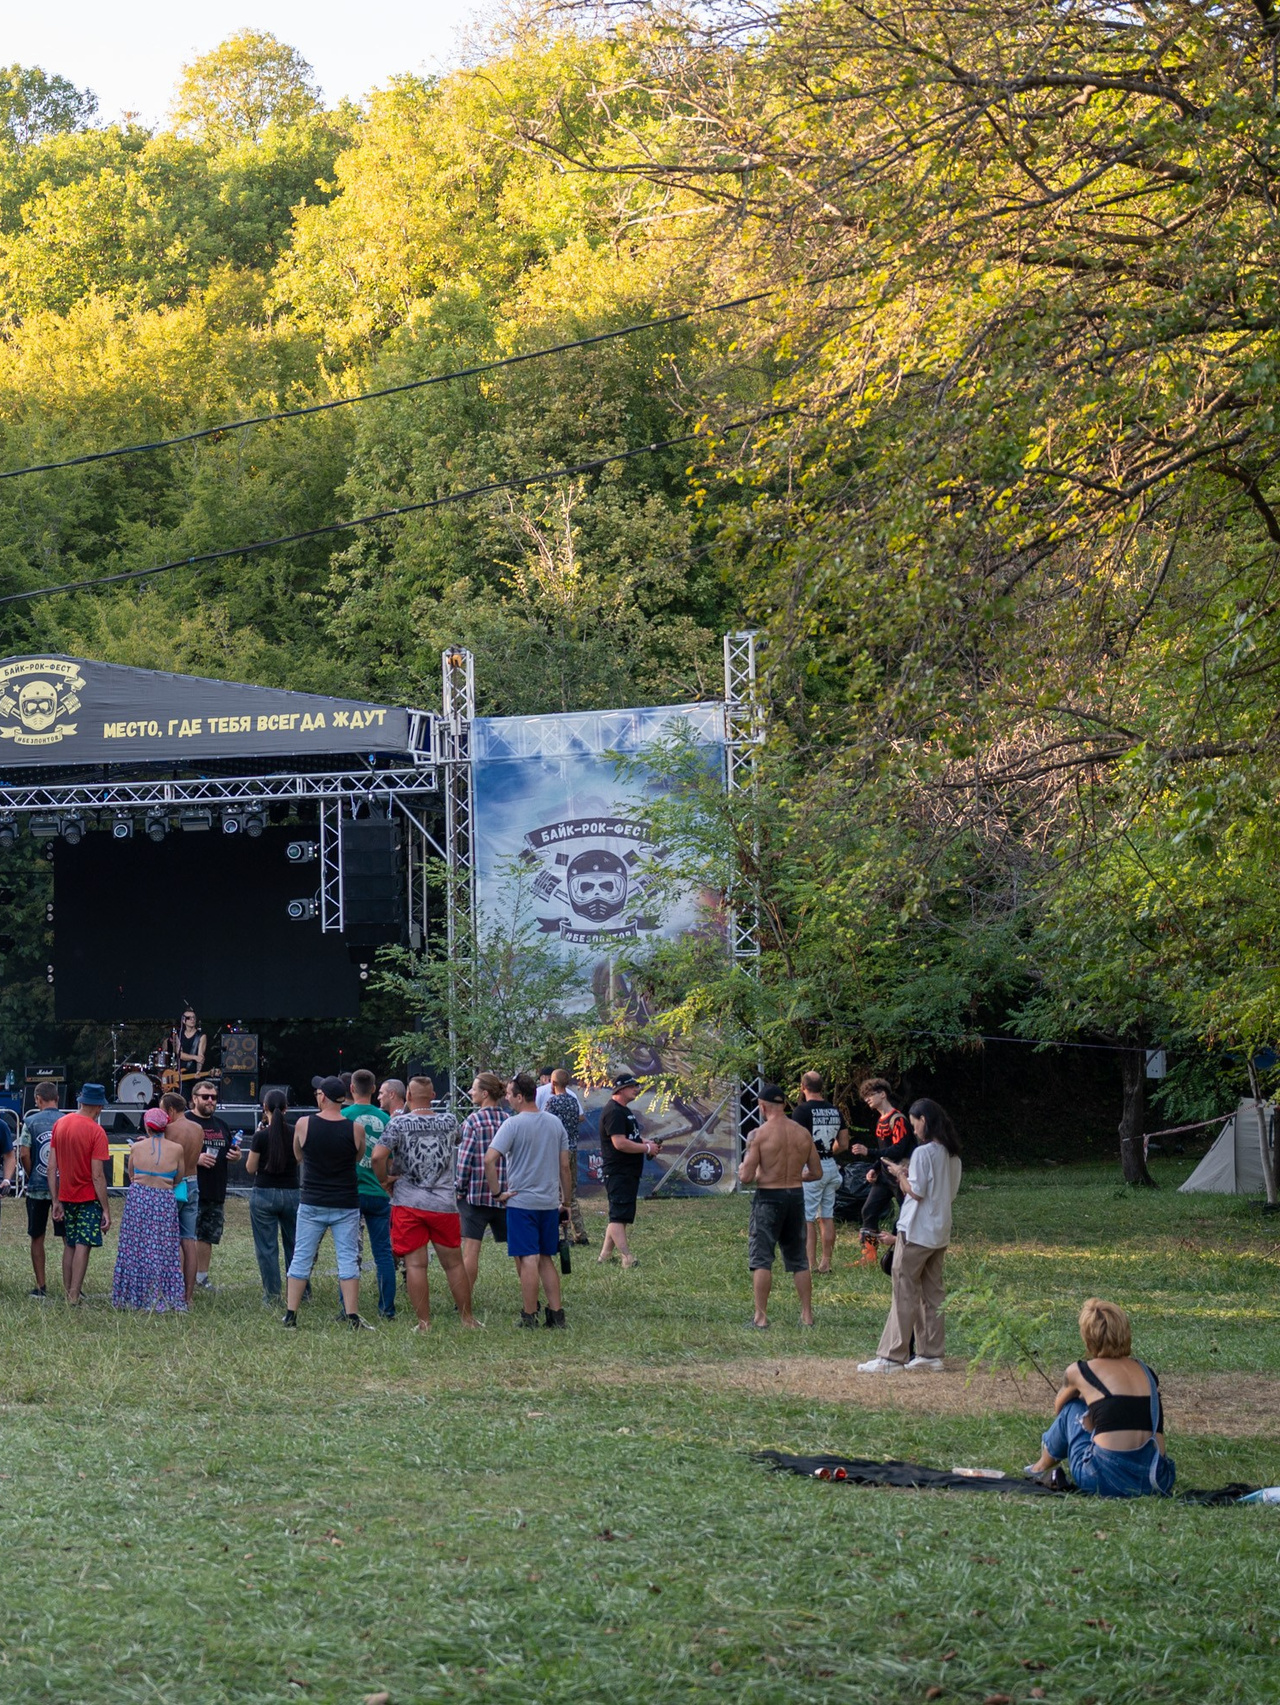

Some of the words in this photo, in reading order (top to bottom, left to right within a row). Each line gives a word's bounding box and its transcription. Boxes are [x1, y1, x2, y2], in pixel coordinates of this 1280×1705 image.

[4, 663, 72, 677] БАЙК-РОК-ФЕСТ
[103, 720, 163, 739] МЕСТО,
[168, 718, 202, 737] ГДЕ
[207, 715, 251, 734] ТЕБЯ
[257, 712, 325, 732] ВСЕГДА
[332, 709, 387, 729] ЖДУТ
[17, 735, 59, 744] #БЕЗПОНТОВ
